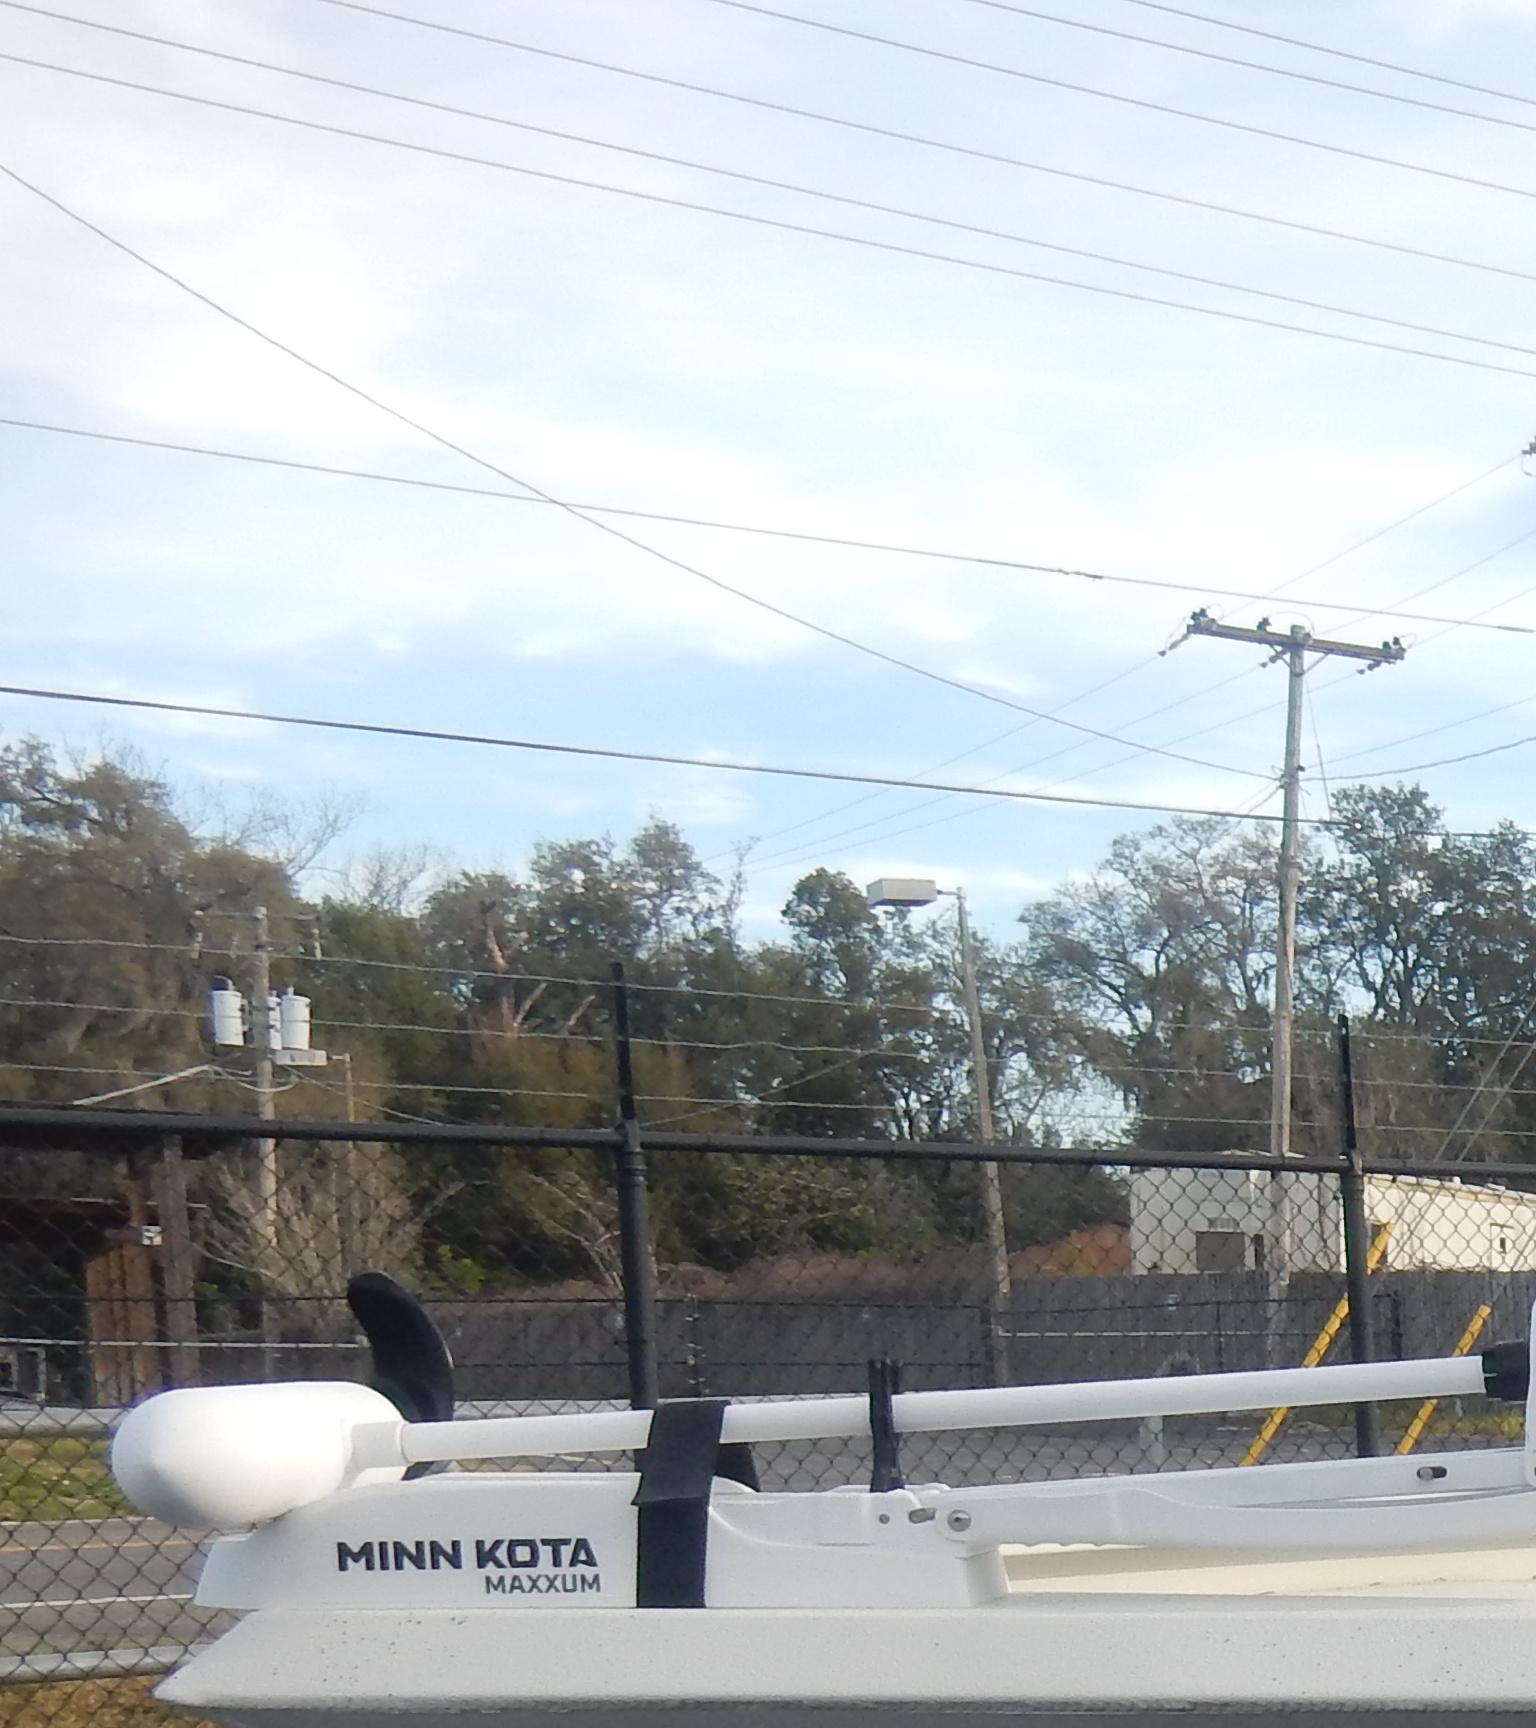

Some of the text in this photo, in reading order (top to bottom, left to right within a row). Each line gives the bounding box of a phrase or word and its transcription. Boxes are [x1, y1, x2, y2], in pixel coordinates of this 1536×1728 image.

[338, 1537, 599, 1571] MINN KOTA
[484, 1573, 602, 1594] MAXXUM
